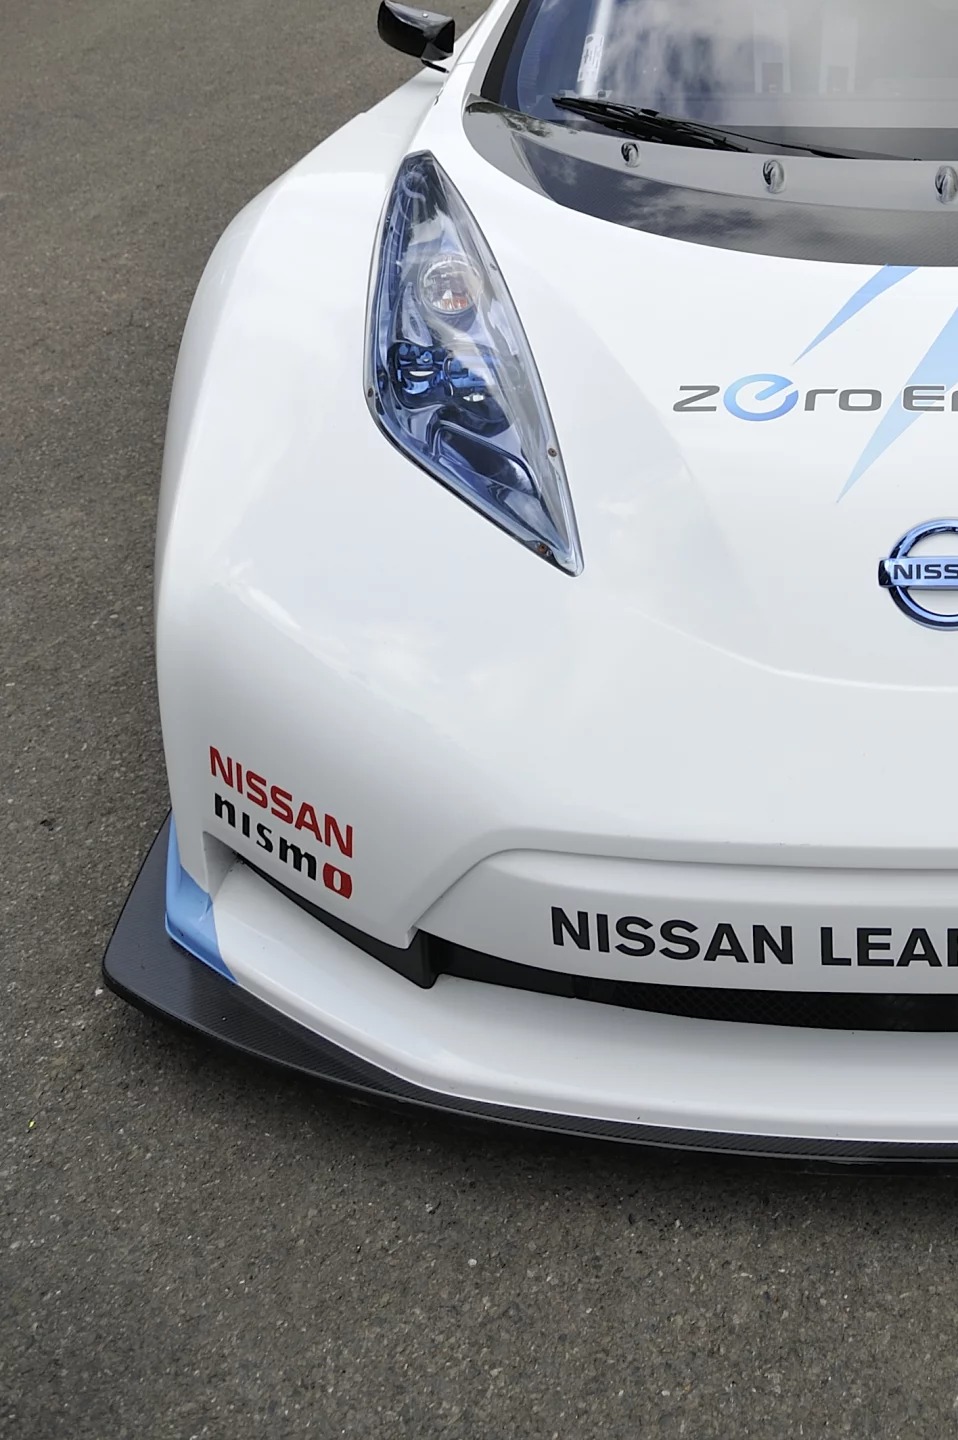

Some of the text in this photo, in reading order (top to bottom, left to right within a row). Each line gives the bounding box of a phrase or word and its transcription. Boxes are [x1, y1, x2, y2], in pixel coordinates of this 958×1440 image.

[209, 745, 354, 859] NISSAN
[214, 792, 353, 900] nismo
[550, 906, 796, 965] NISSAN
